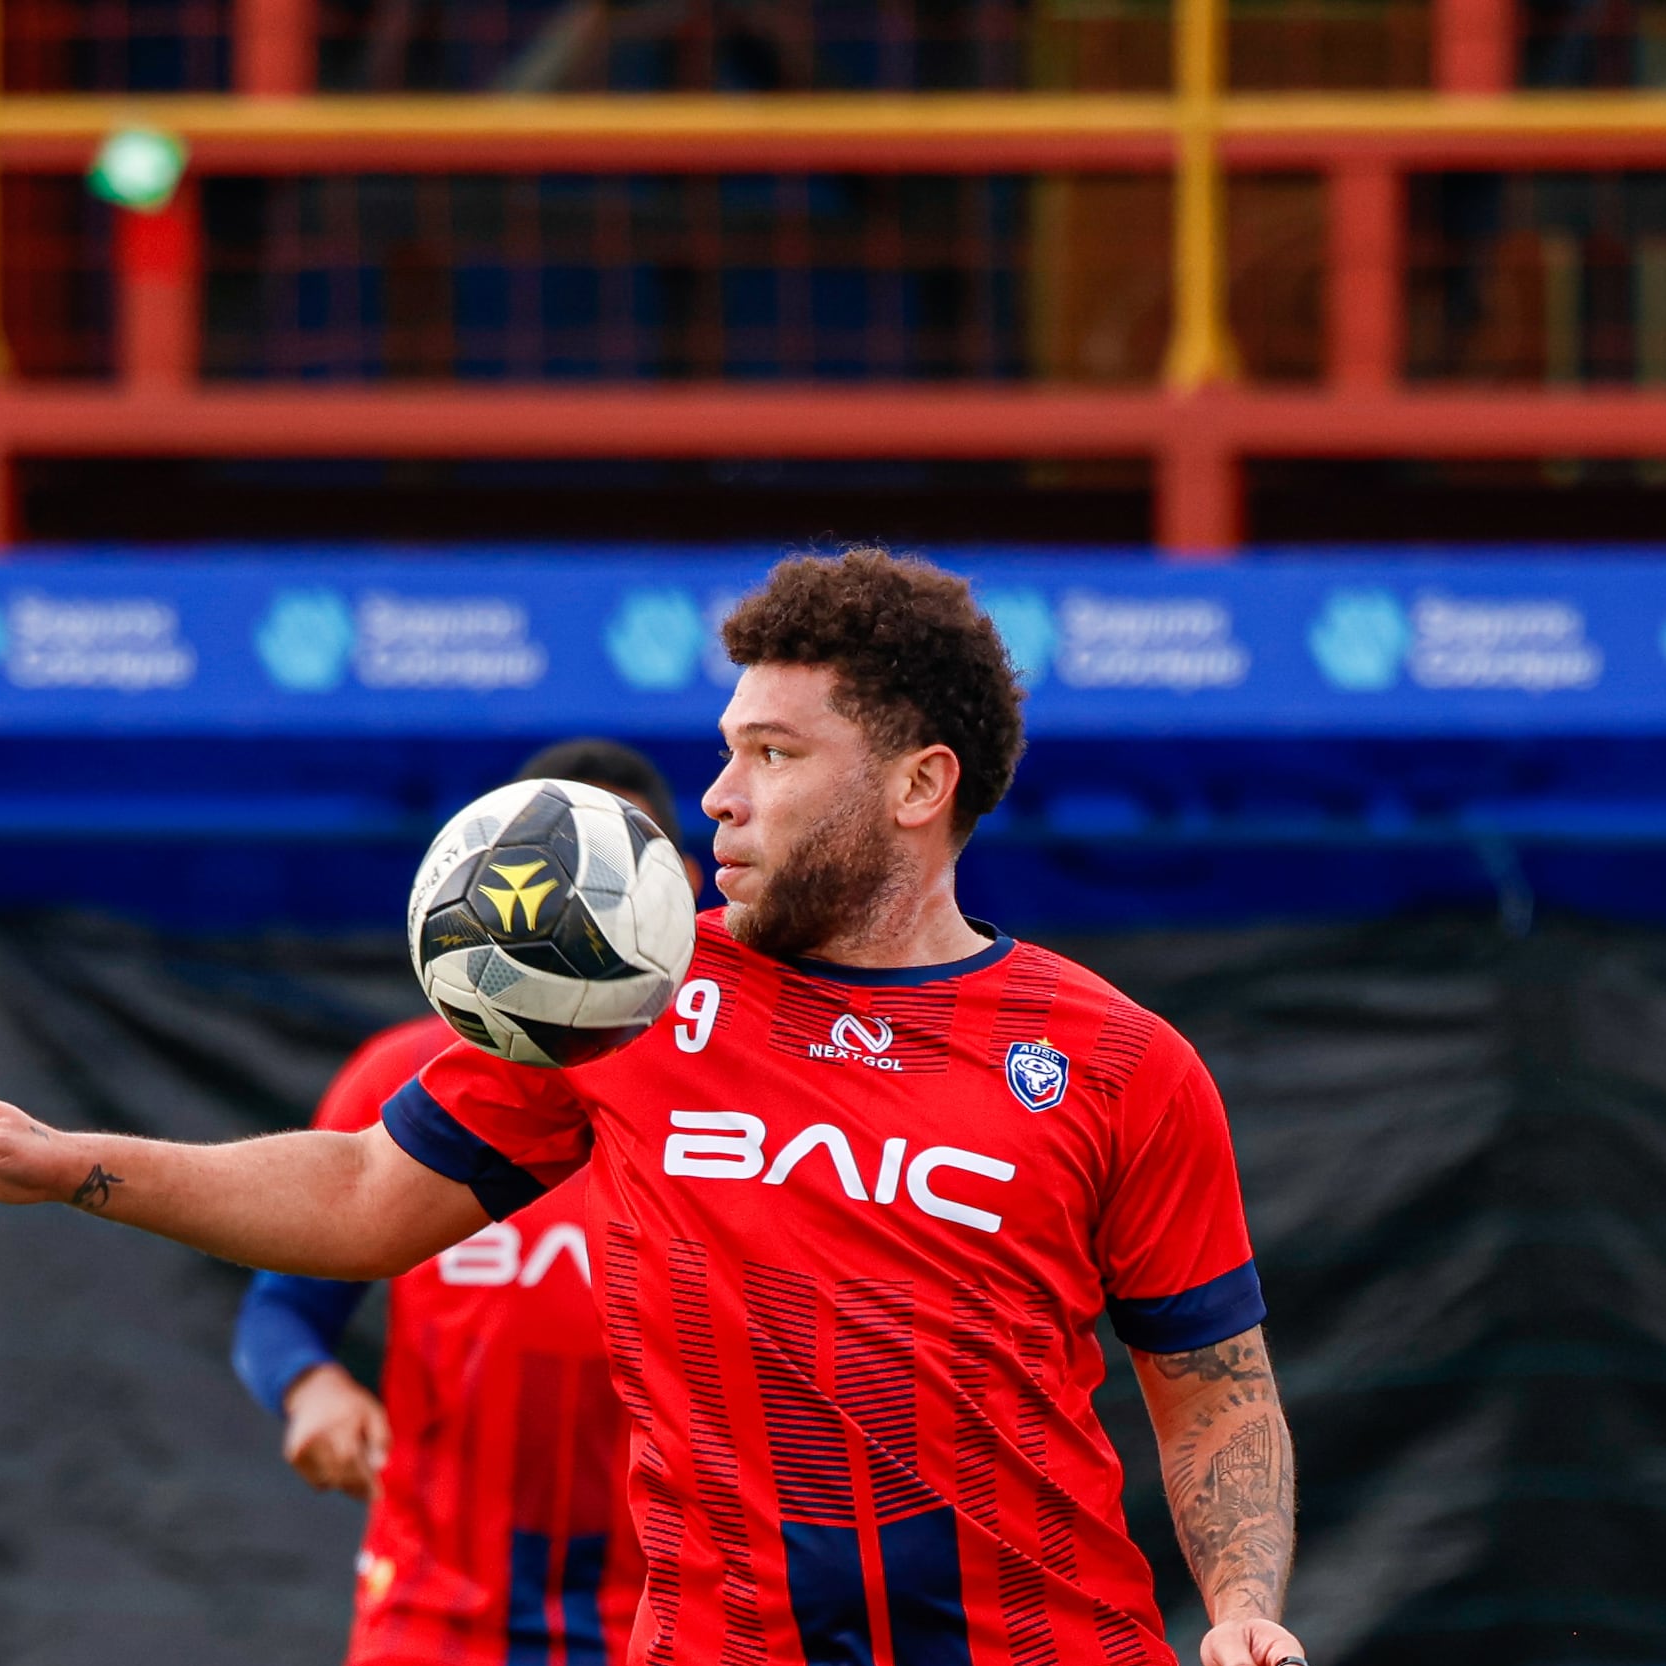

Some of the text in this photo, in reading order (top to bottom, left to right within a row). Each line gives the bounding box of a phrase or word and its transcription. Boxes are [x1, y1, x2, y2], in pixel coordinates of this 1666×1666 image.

[674, 979, 720, 1053] 9
[809, 1044, 904, 1071] NEXTGOL
[1019, 1044, 1060, 1064] ADSC
[663, 1110, 1016, 1234] BAIC
